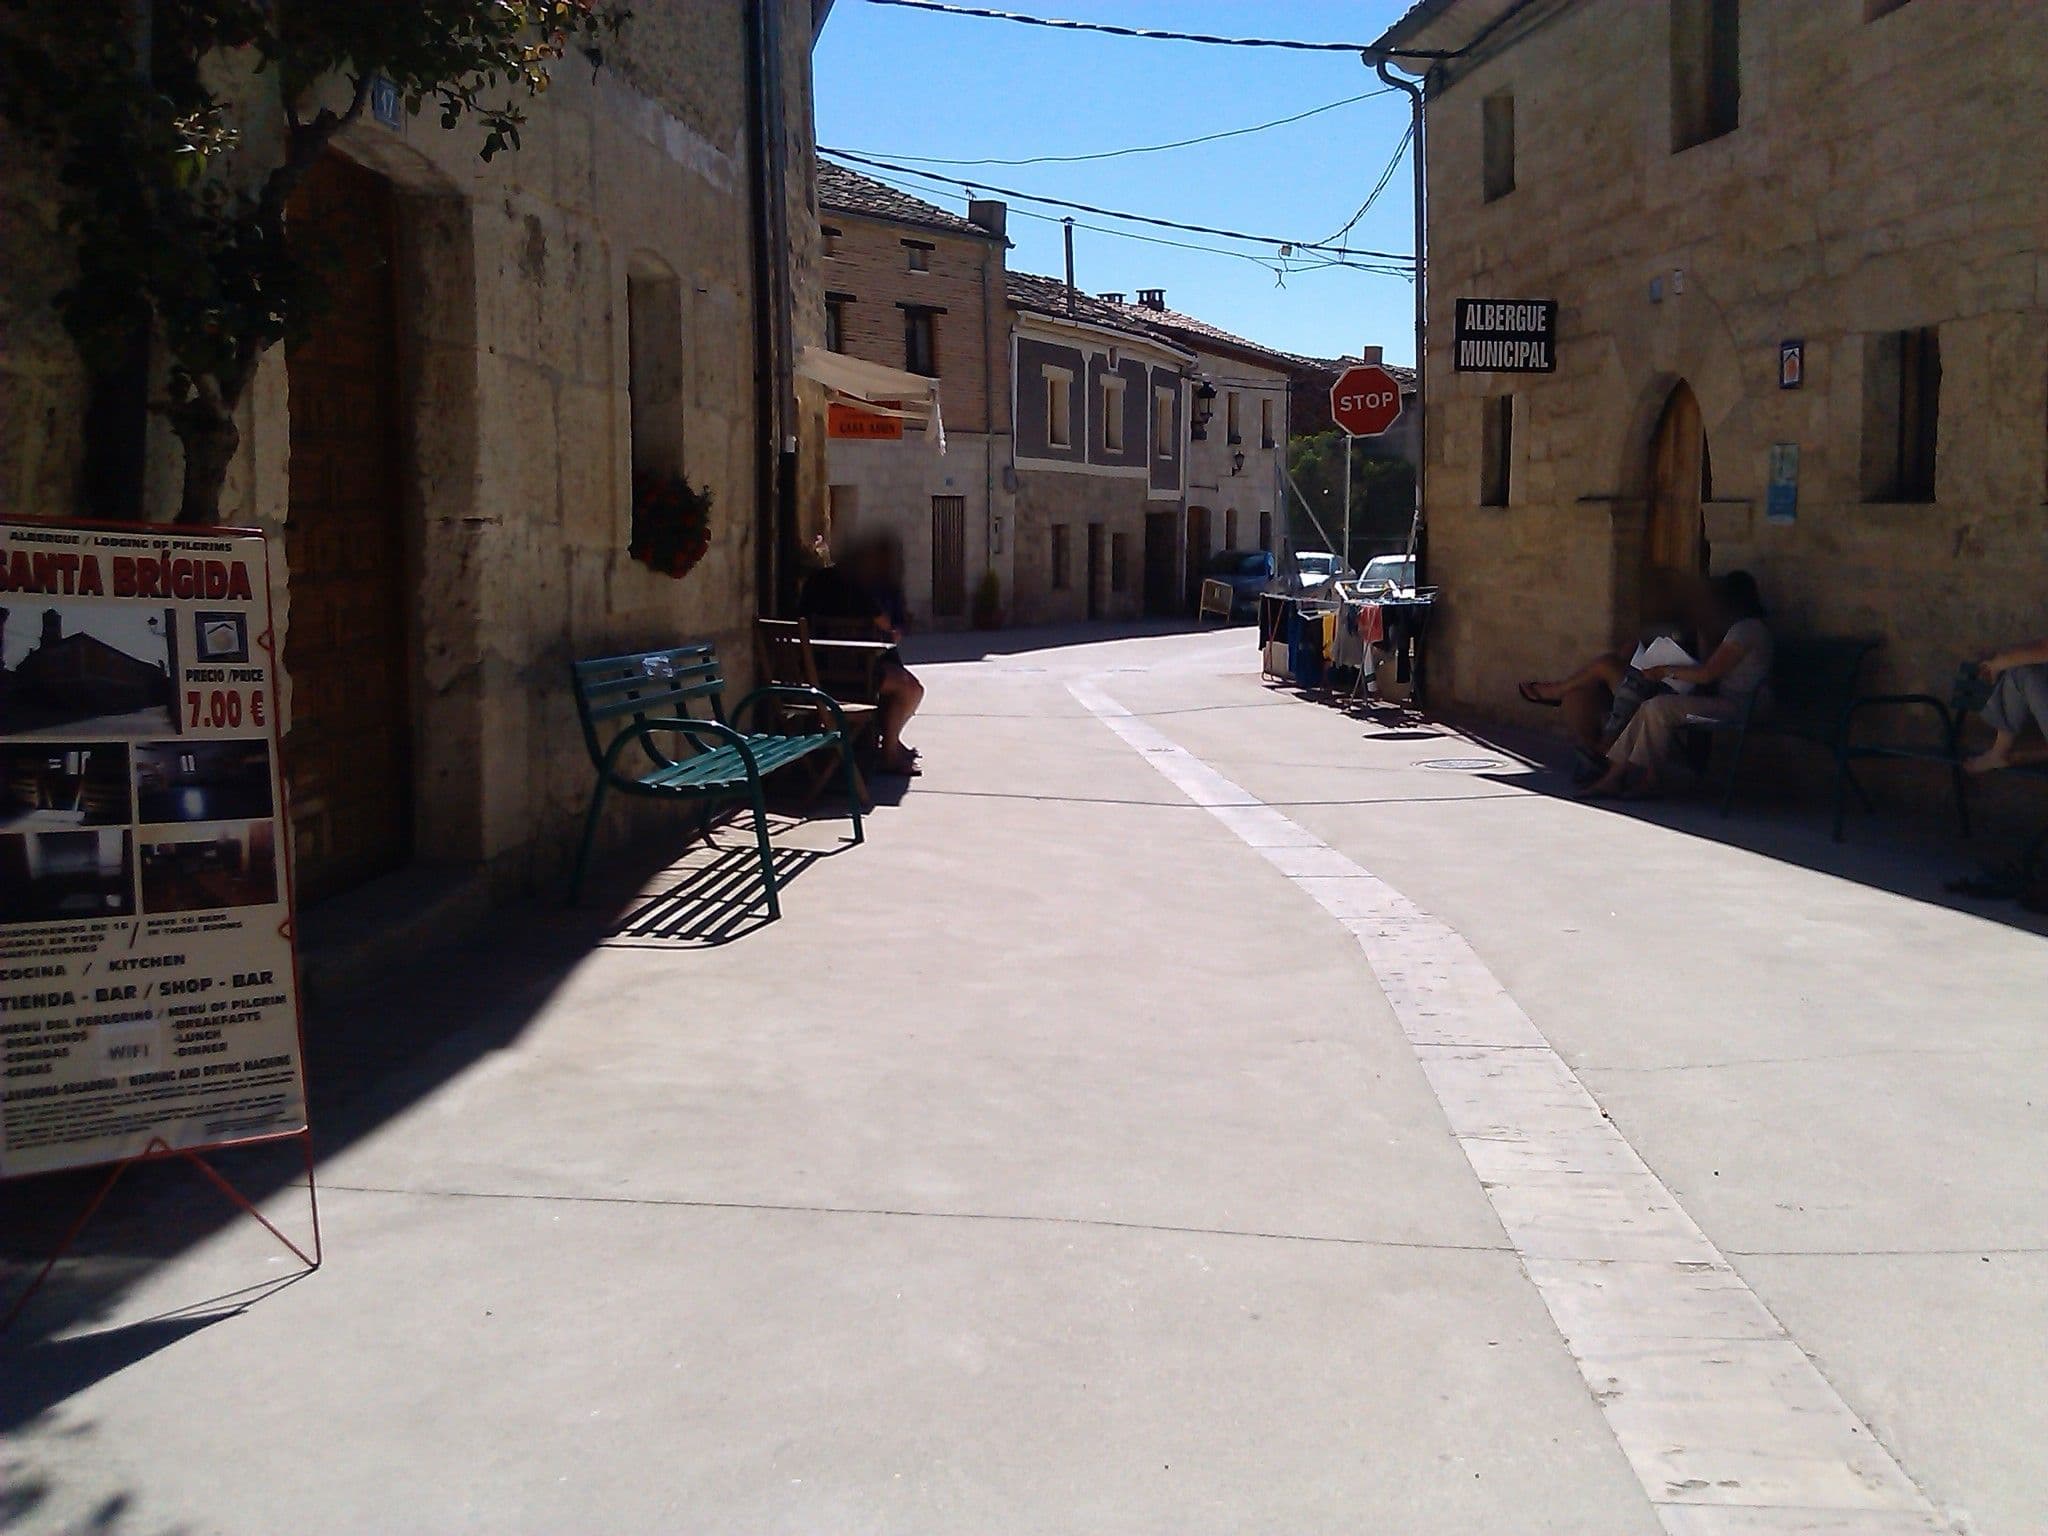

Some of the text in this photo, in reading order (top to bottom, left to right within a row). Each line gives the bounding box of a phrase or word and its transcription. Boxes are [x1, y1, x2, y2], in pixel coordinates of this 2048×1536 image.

[1465, 304, 1547, 332] ALBERGUE
[1460, 340, 1549, 368] MUNICIPAL
[1340, 391, 1394, 412] STOP
[10, 531, 80, 545] ALBERGUE
[94, 536, 149, 549] LODGING
[153, 540, 169, 549] OF
[173, 541, 232, 552] PILGRIMS
[113, 550, 253, 600] BRÍGIDA
[186, 669, 225, 683] PRECIO
[188, 690, 265, 728] 7.00 €
[0, 965, 66, 980] COCINA
[109, 954, 185, 971] KITCHEN
[0, 991, 75, 1011] TIENDA
[96, 985, 137, 1002] BAR
[160, 977, 212, 996] SHOP
[233, 971, 273, 988] BAR
[168, 1003, 206, 1017] MENU
[211, 1001, 227, 1012] OF
[231, 995, 287, 1010] PILGRIM
[179, 1067, 200, 1080] AND
